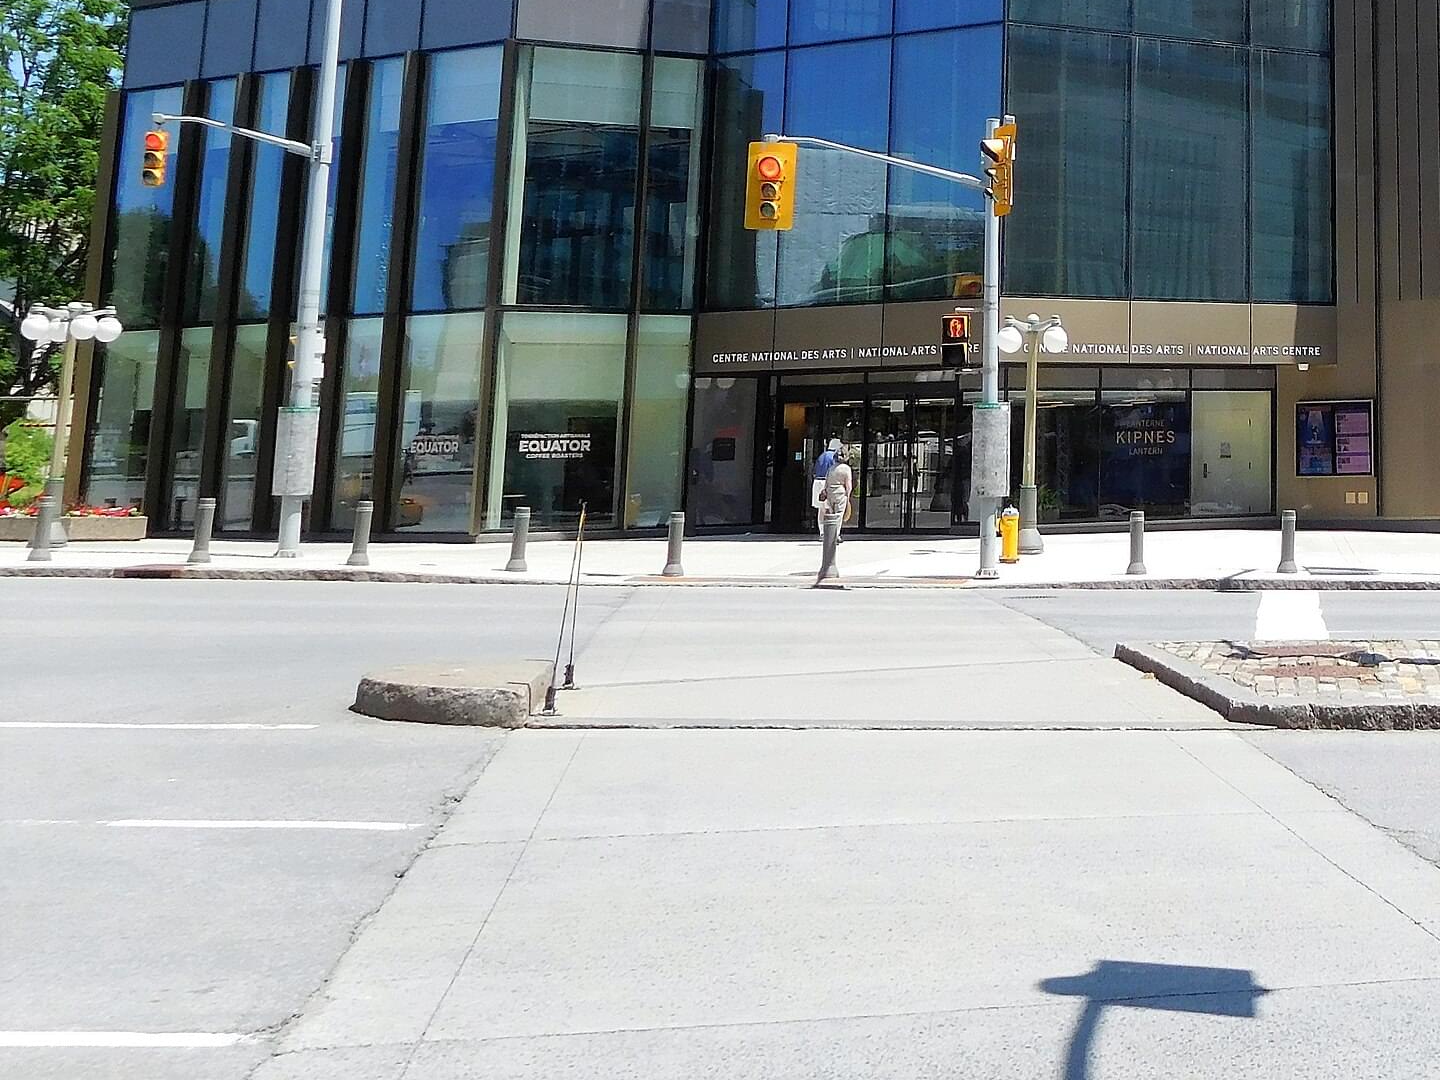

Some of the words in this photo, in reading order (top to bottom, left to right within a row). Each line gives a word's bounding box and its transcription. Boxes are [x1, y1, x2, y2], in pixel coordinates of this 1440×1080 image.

[713, 352, 748, 363] CENTRE
[751, 350, 798, 362] NATIONAL
[801, 350, 819, 360] DES
[822, 348, 847, 359] ARTS
[858, 347, 908, 358] NATIONAL
[911, 345, 937, 356] ARTS
[1072, 344, 1128, 354] NATIONAL
[1131, 344, 1152, 354] DES
[1156, 344, 1184, 354] ARTS
[1197, 344, 1248, 356] NATIONAL
[1252, 345, 1279, 356] ARTS
[1282, 346, 1321, 356] CENTRE
[1115, 430, 1176, 444] KIPNES
[410, 441, 459, 454] EQUATOR
[518, 440, 591, 453] EQUATOR
